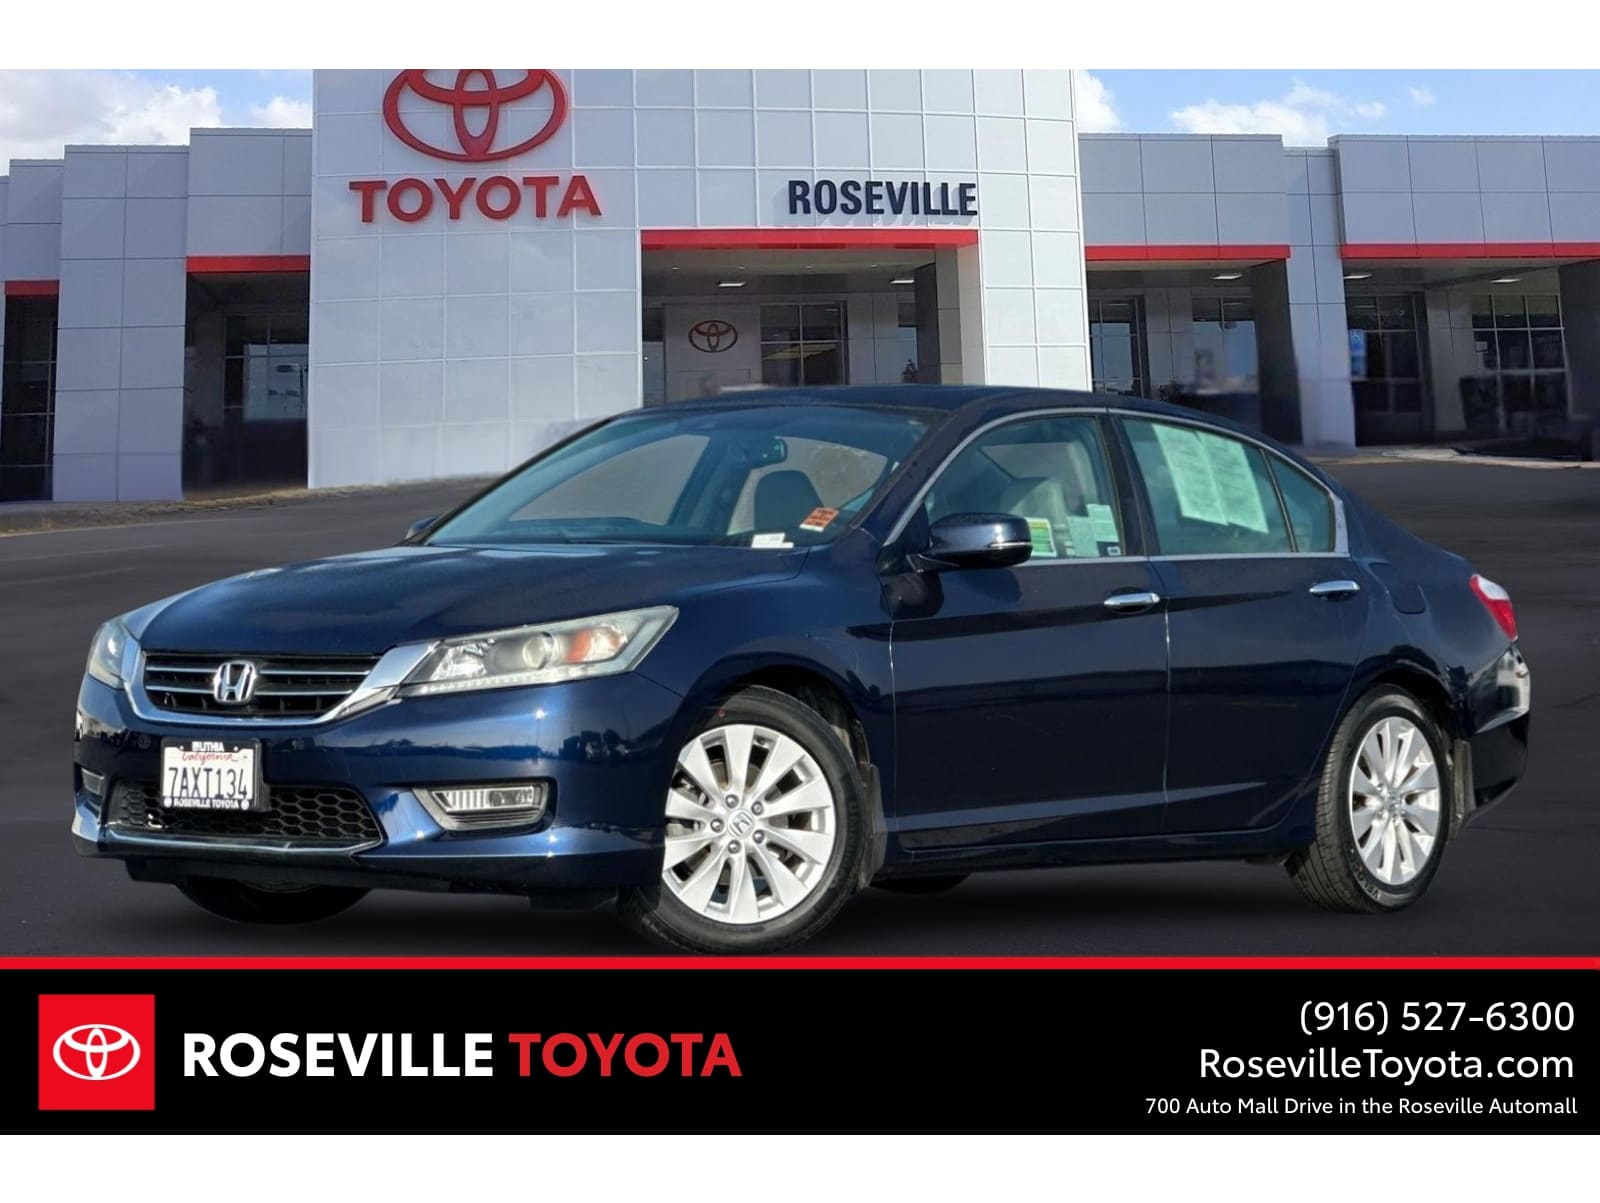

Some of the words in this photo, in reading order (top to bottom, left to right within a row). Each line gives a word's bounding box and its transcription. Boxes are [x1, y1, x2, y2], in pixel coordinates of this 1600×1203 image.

[349, 175, 602, 223] TOYOTA
[788, 179, 978, 216] ROSEVILLE
[168, 767, 248, 799] 7AXT134
[173, 798, 211, 808] ROSEVILLE
[212, 800, 239, 809] TOYOTA
